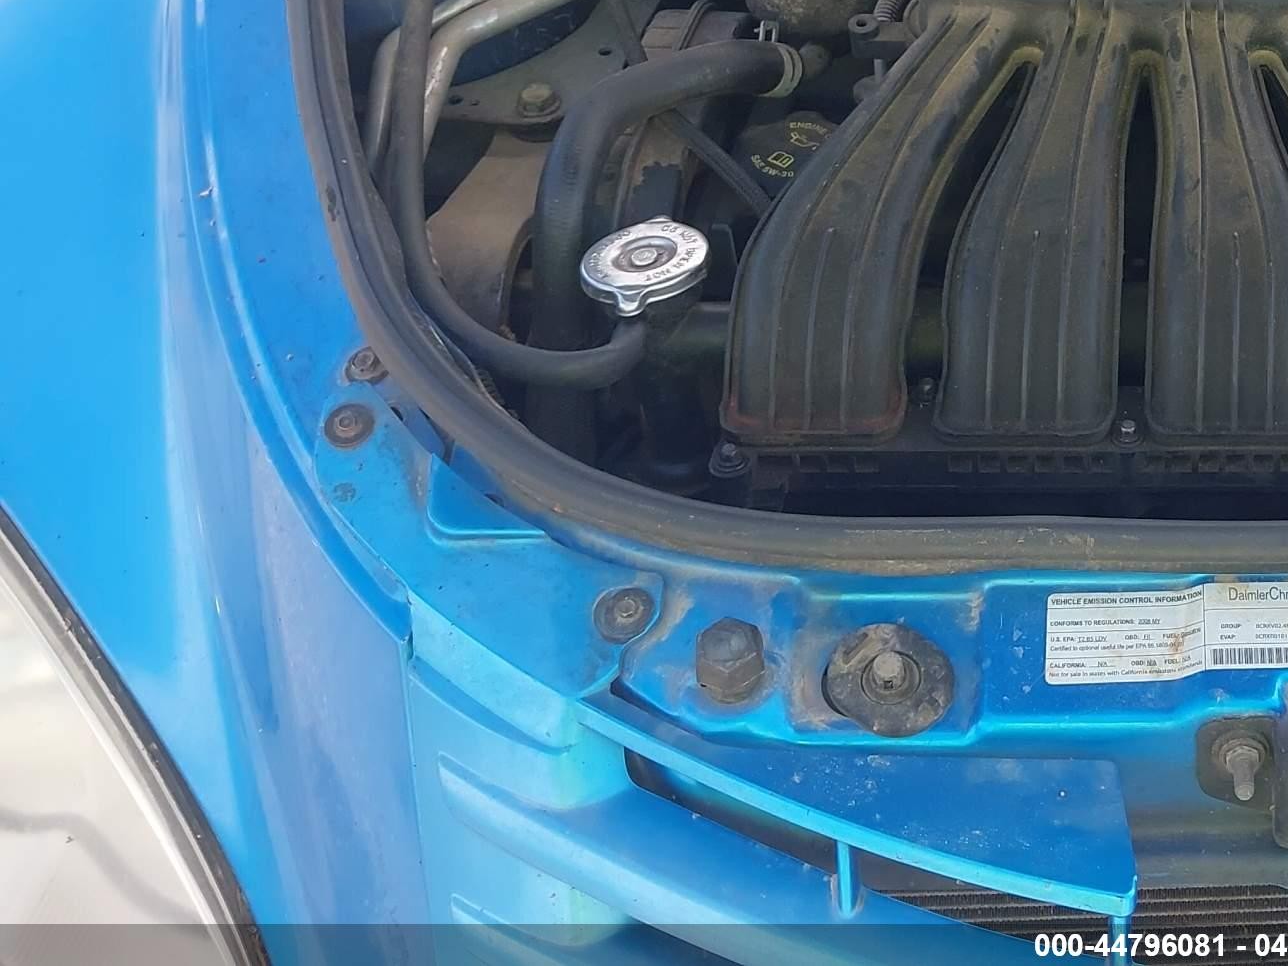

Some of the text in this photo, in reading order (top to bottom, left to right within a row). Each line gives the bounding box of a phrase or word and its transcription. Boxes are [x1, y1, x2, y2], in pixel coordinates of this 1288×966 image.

[1051, 589, 1202, 605] VEHICLE EMISSION CONTROL INFORMATION
[1050, 619, 1083, 627] CONFORMS
[1050, 644, 1071, 652] Certified
[1079, 644, 1100, 652] optional
[1121, 668, 1148, 676] California
